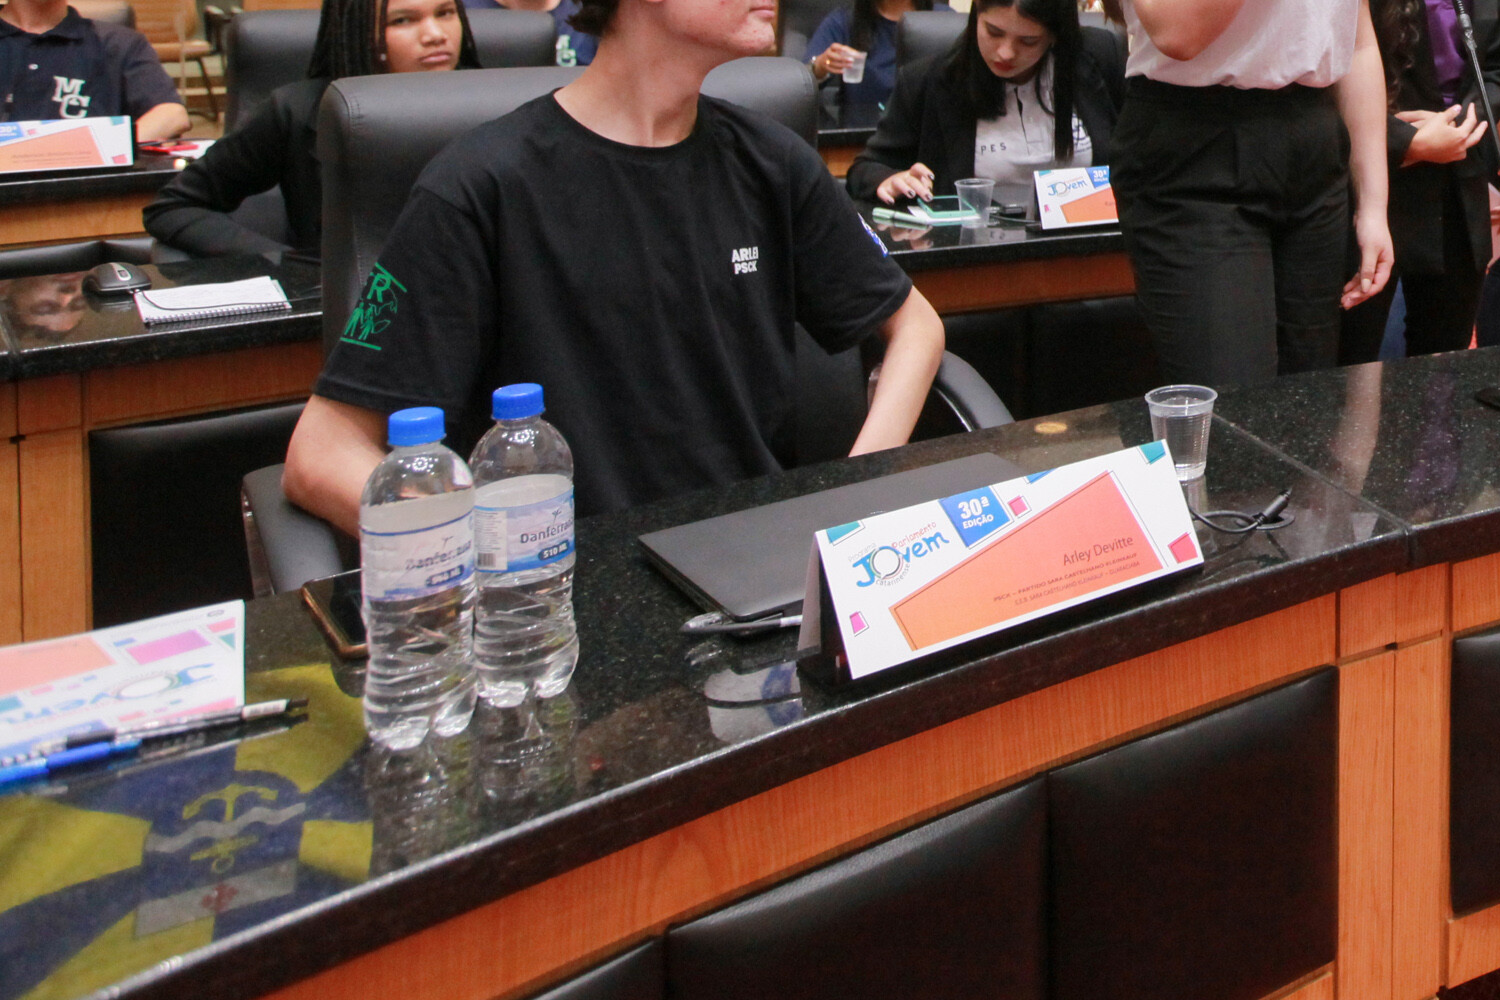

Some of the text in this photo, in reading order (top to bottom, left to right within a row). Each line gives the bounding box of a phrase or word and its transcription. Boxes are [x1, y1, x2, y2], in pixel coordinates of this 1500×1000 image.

[734, 260, 757, 275] PSCK
[958, 496, 990, 519] 30ª
[962, 513, 994, 529] EDIÇÃO
[891, 521, 937, 549] Parlamento
[543, 547, 558, 559] 510
[1063, 535, 1134, 566] Arley Devitte
